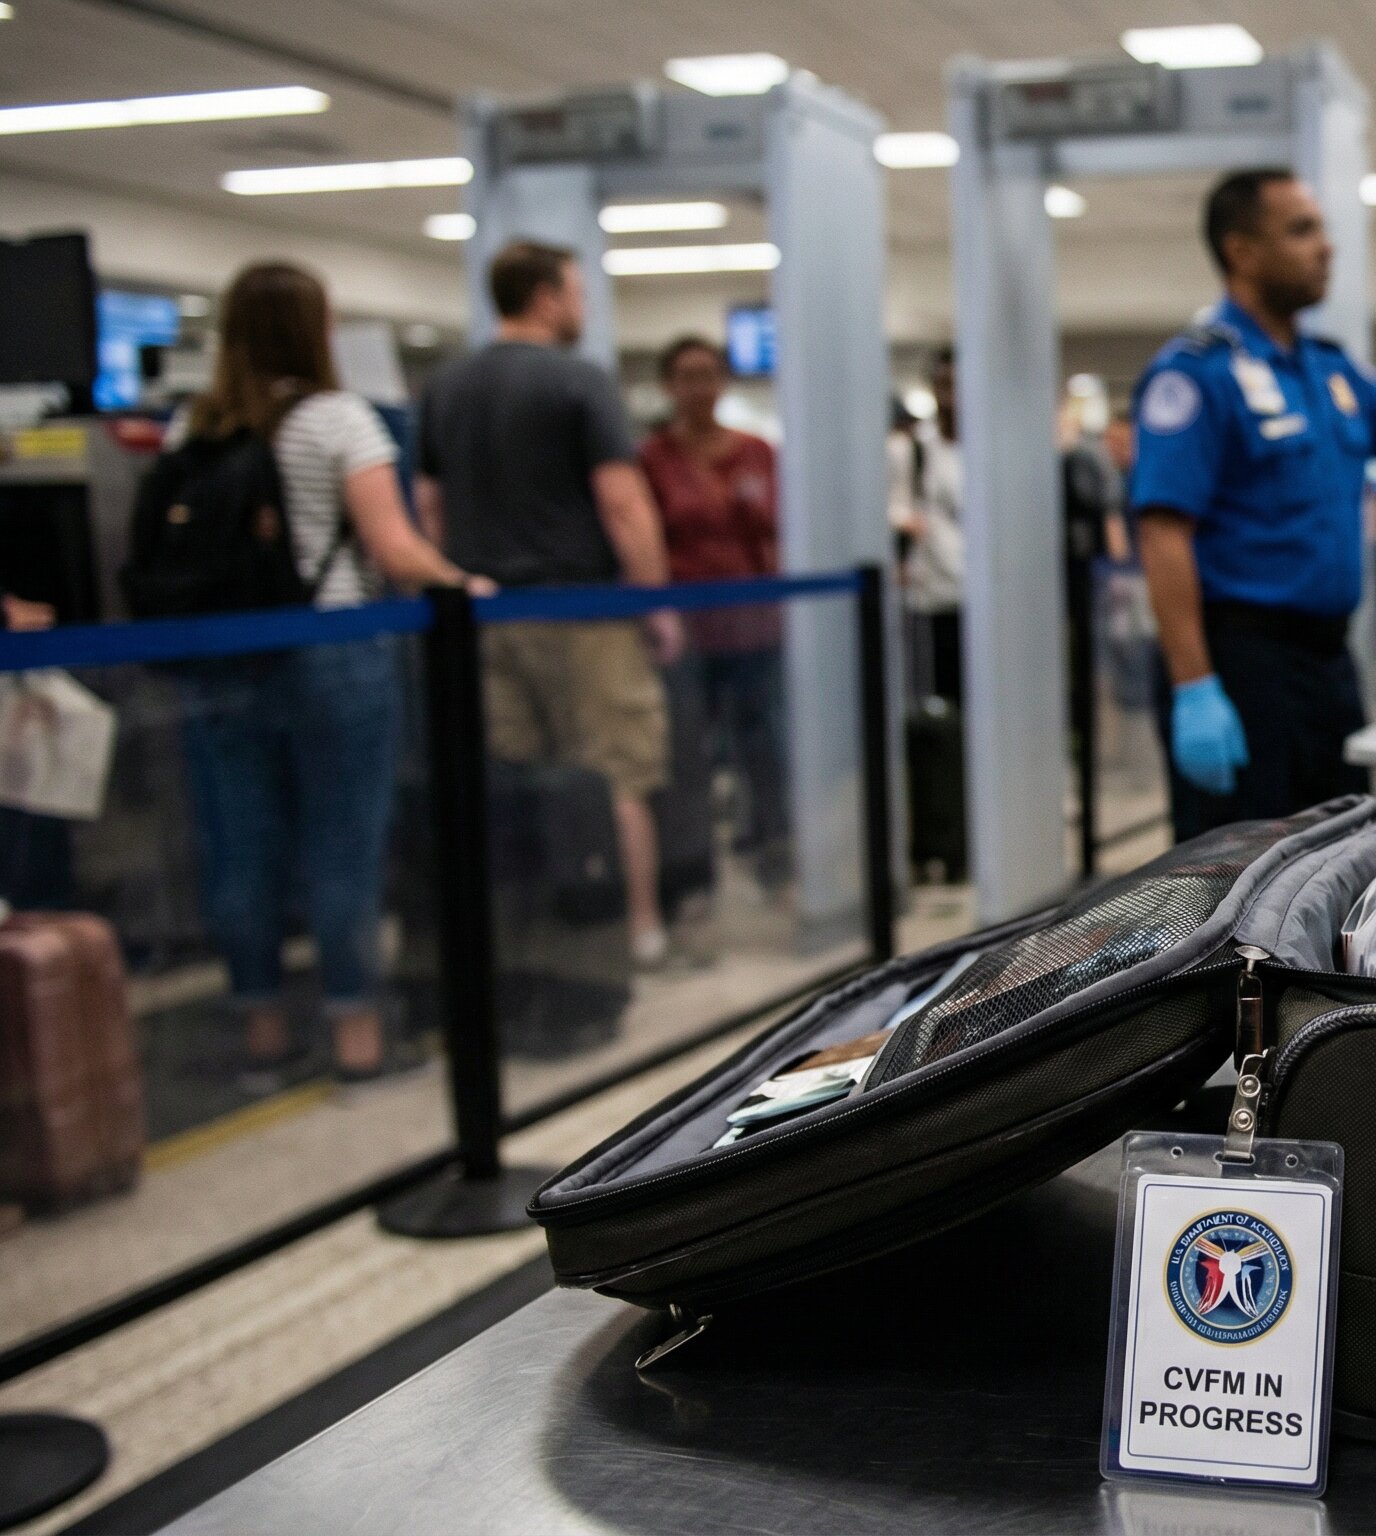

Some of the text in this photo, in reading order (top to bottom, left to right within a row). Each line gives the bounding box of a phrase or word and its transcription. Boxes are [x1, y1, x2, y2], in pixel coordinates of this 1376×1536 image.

[1164, 1366, 1283, 1398] CVFM IN
[1139, 1401, 1303, 1437] PROGRESS
